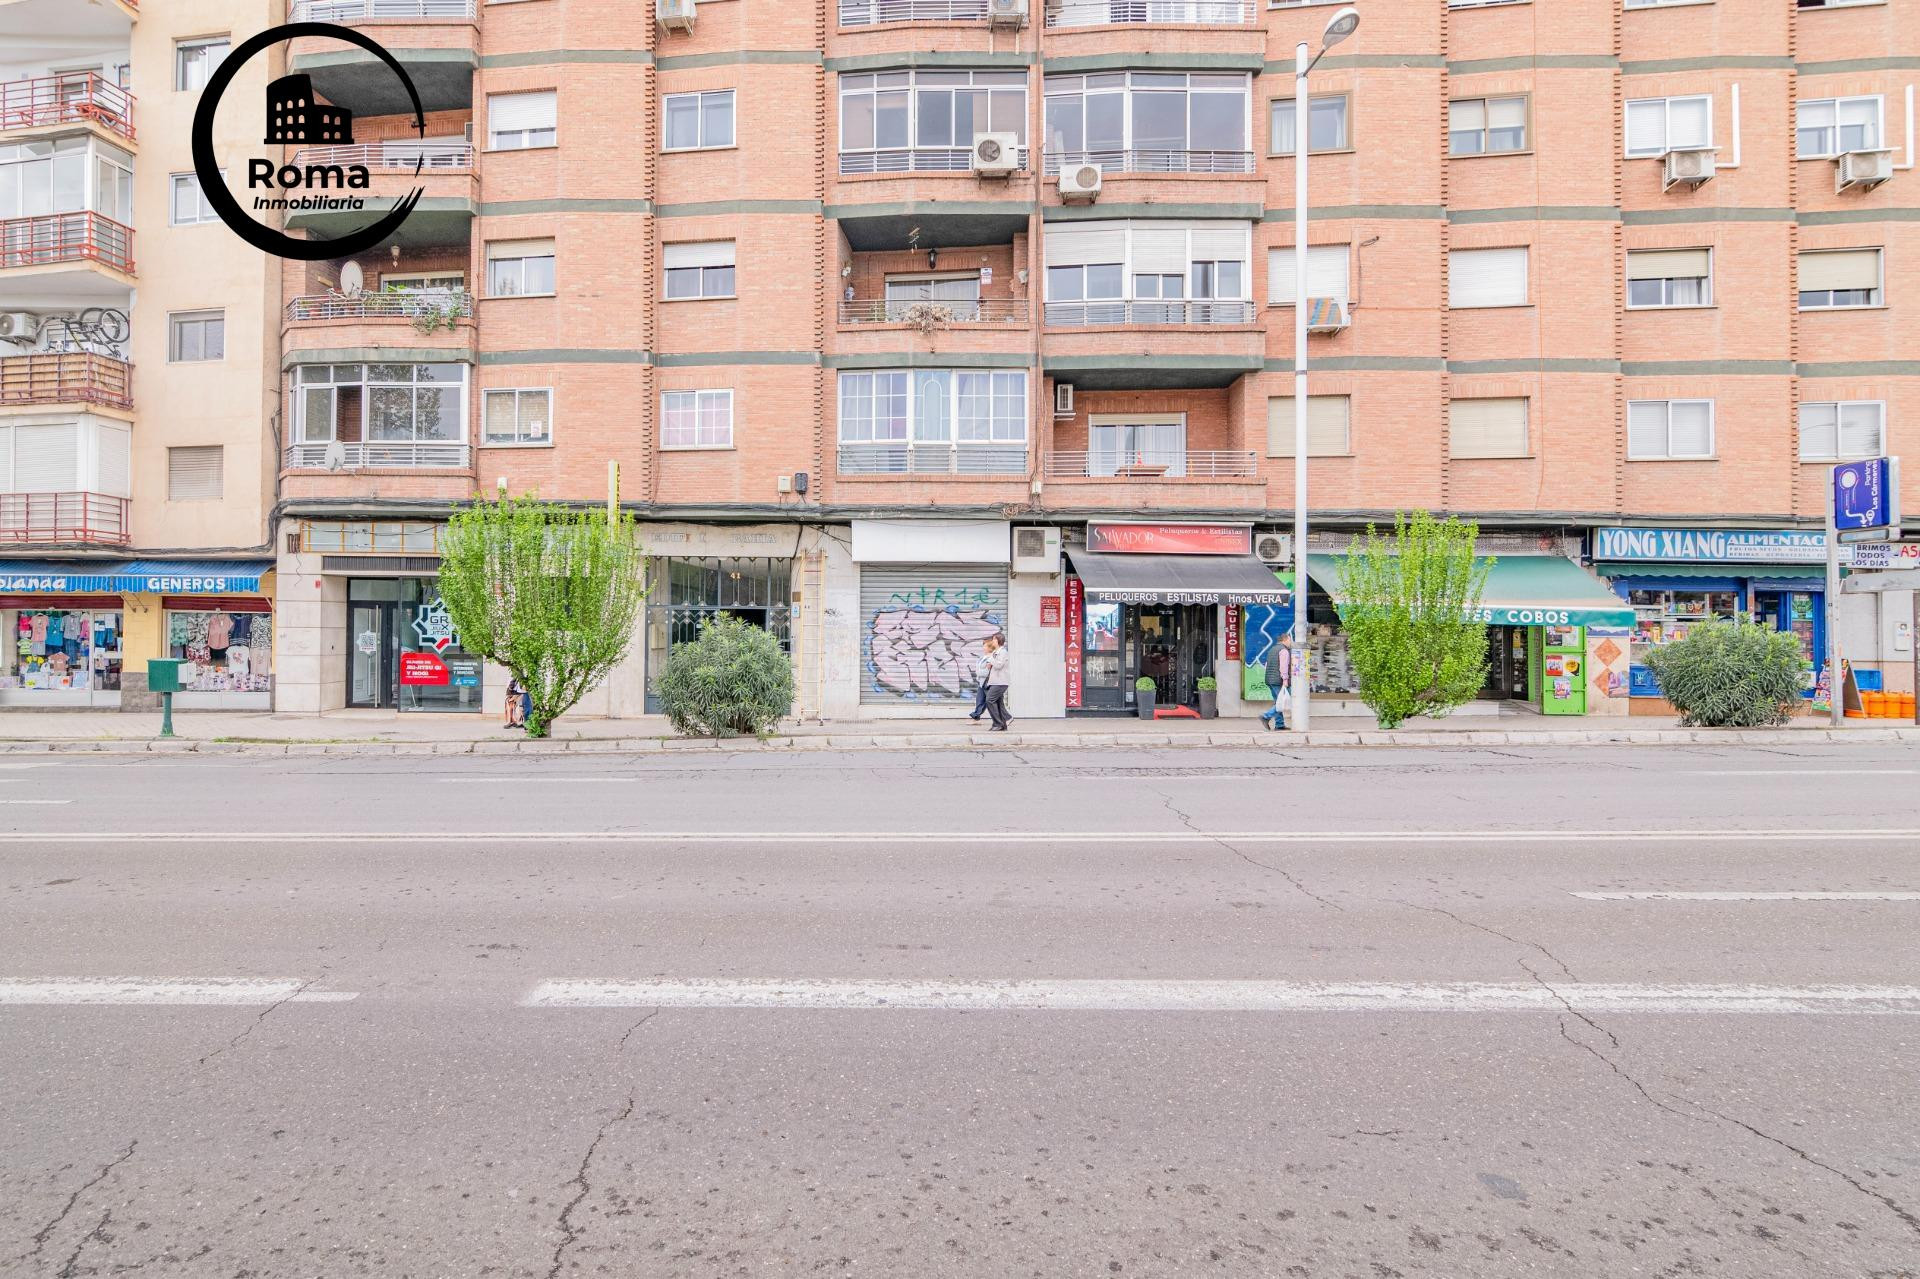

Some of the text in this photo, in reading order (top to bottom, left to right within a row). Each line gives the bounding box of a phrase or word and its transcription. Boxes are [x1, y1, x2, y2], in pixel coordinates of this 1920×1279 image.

[1602, 530, 1725, 558] YONG XIANG
[1900, 545, 1920, 558] AS
[729, 572, 741, 580] 41
[148, 577, 225, 590] GENEROS
[1099, 592, 1158, 602] PELUQUEROS
[1167, 593, 1219, 602] ESTILISTAS
[430, 616, 449, 624] GR
[1068, 580, 1079, 649] ESTILISTA
[1507, 609, 1569, 624] COBOS
[1068, 657, 1079, 705] UNISEX
